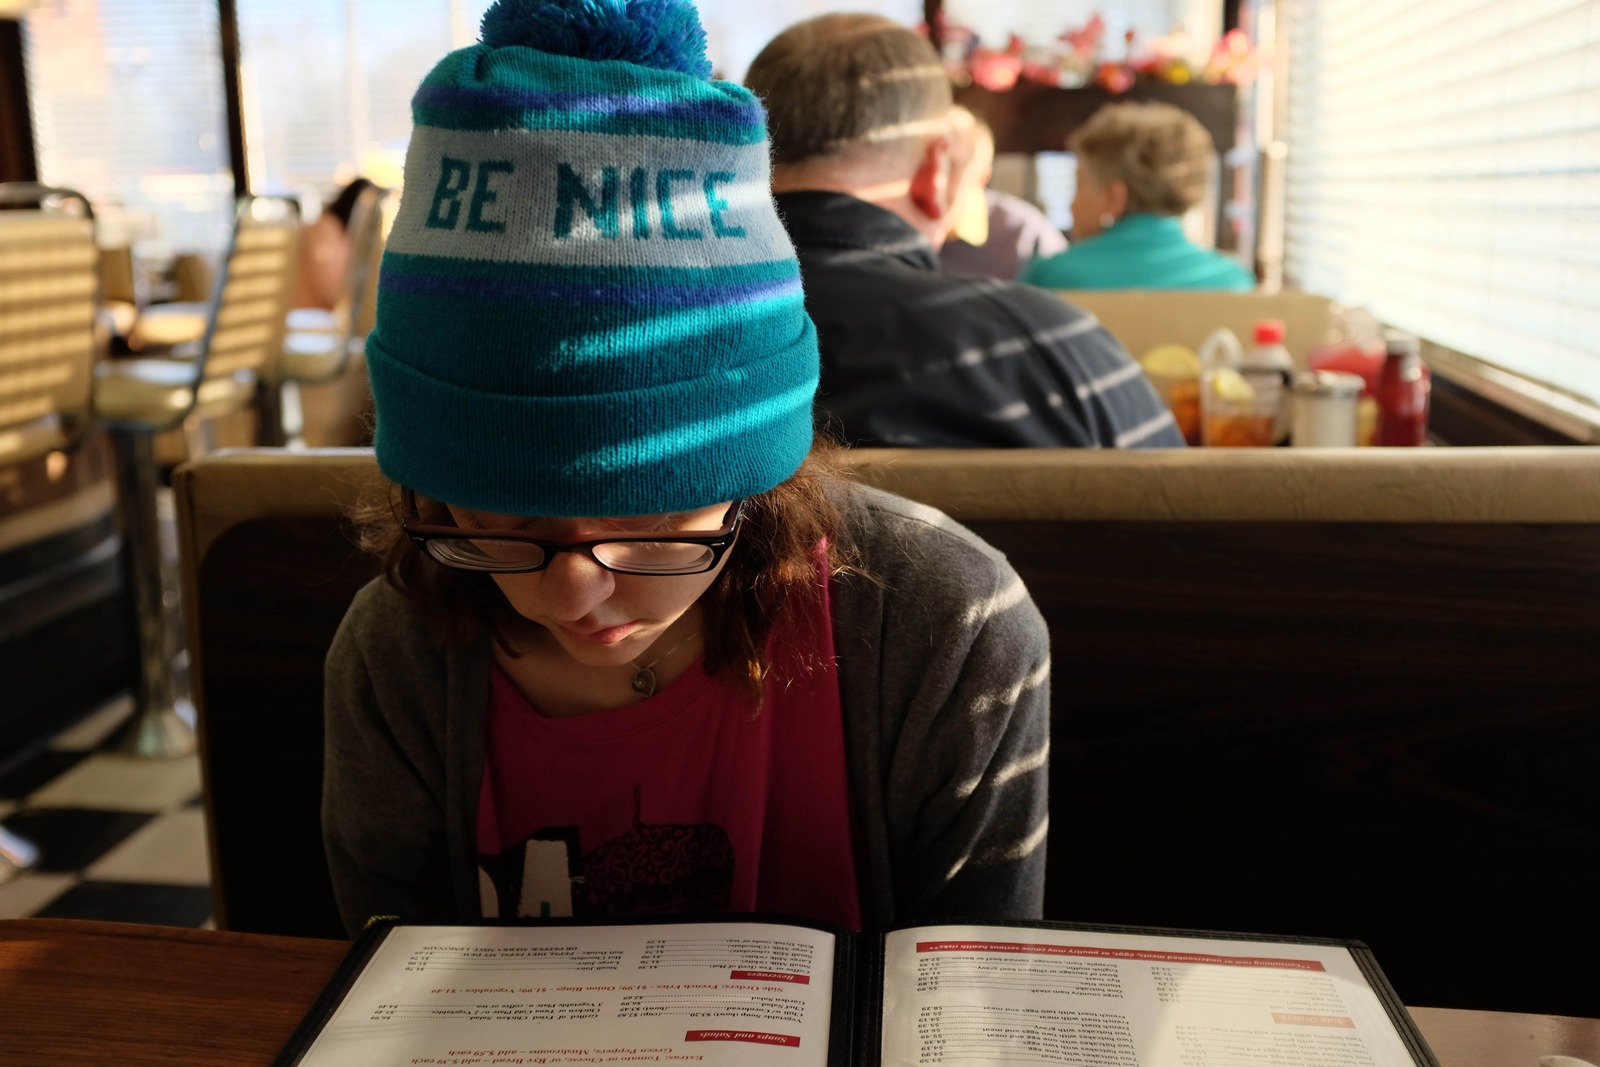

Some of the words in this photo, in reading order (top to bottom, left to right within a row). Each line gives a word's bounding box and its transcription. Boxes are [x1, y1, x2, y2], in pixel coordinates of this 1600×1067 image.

[425, 156, 514, 233] BE
[553, 163, 748, 241] NICE
[763, 1015, 801, 1024] Vegetable
[756, 1034, 787, 1043] Soups
